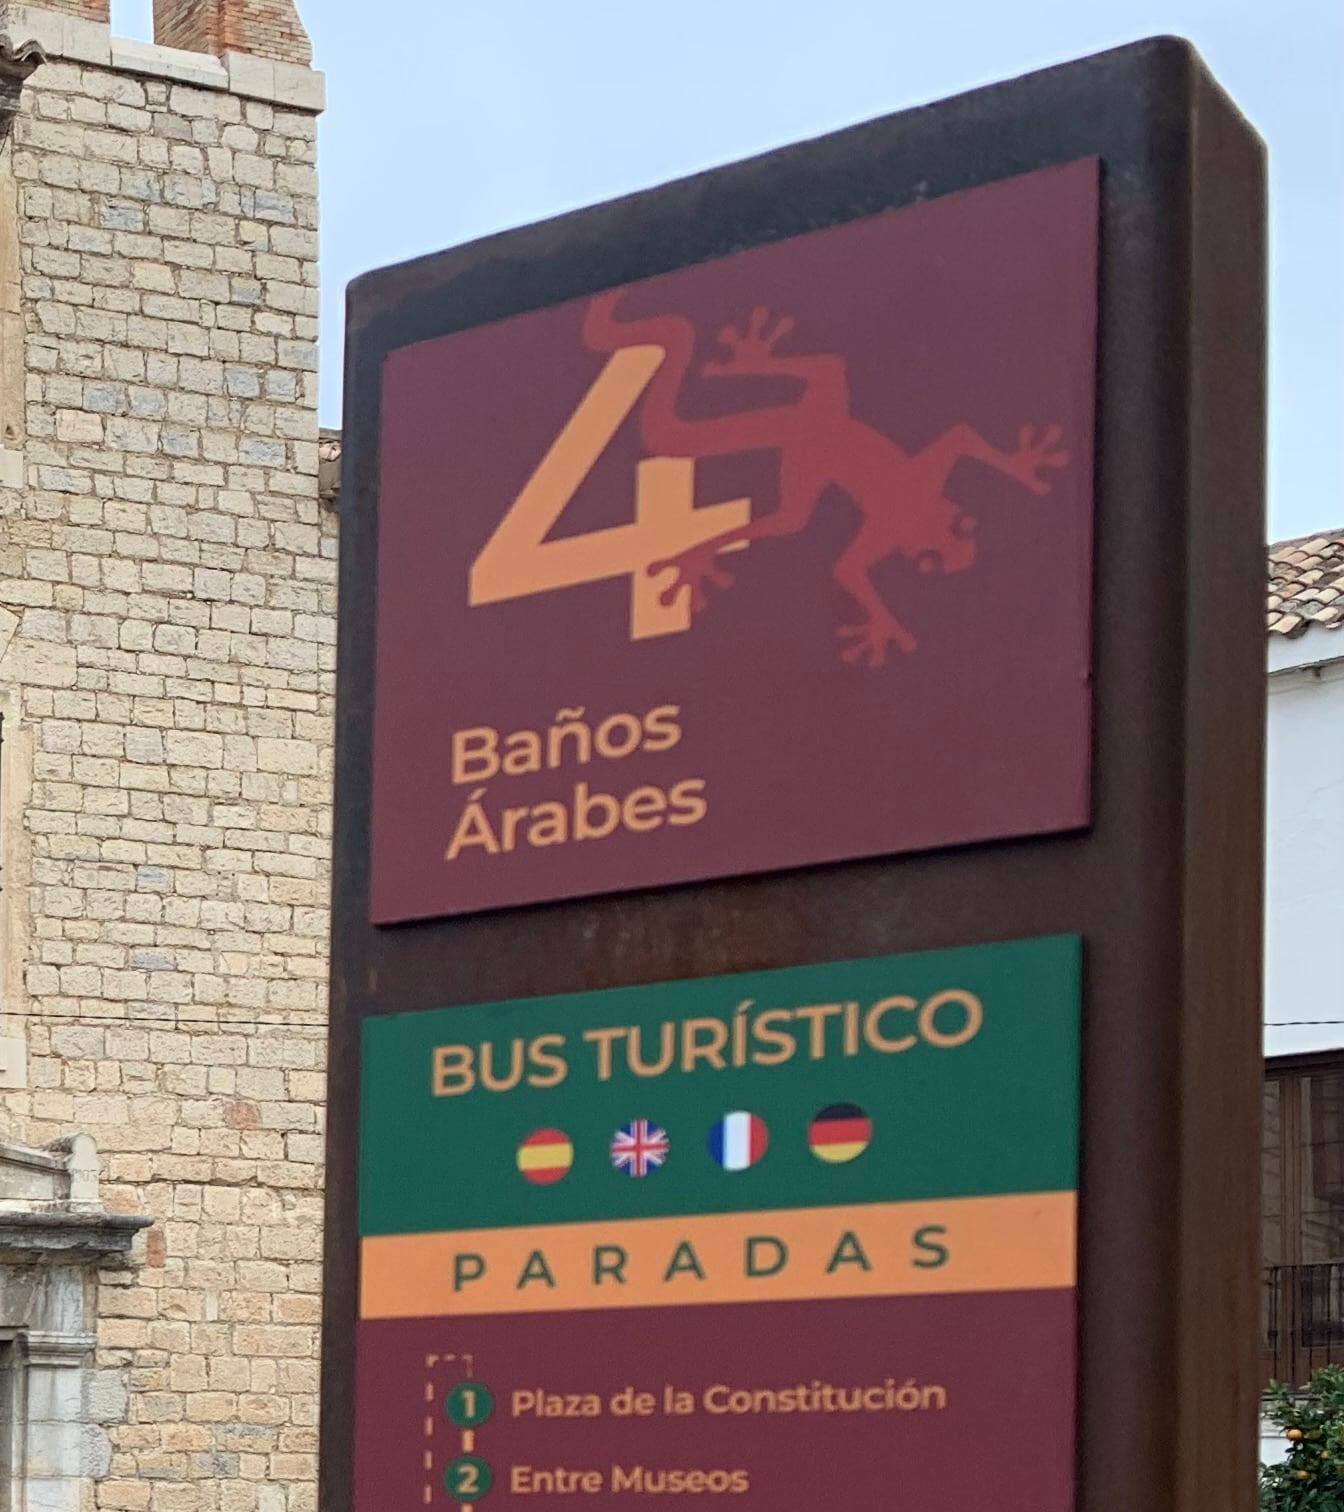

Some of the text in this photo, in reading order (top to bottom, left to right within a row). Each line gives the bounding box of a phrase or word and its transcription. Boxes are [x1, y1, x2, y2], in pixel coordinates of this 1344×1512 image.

[468, 346, 750, 641] 4
[450, 703, 683, 784] Baños
[445, 779, 708, 861] Árabes
[431, 988, 984, 1097] BUS TURÍSTICO
[453, 1226, 951, 1292] PARADAS
[461, 1379, 948, 1419] 1 Plaza de la Constitución
[456, 1466, 750, 1495] 2 Entre Museos
